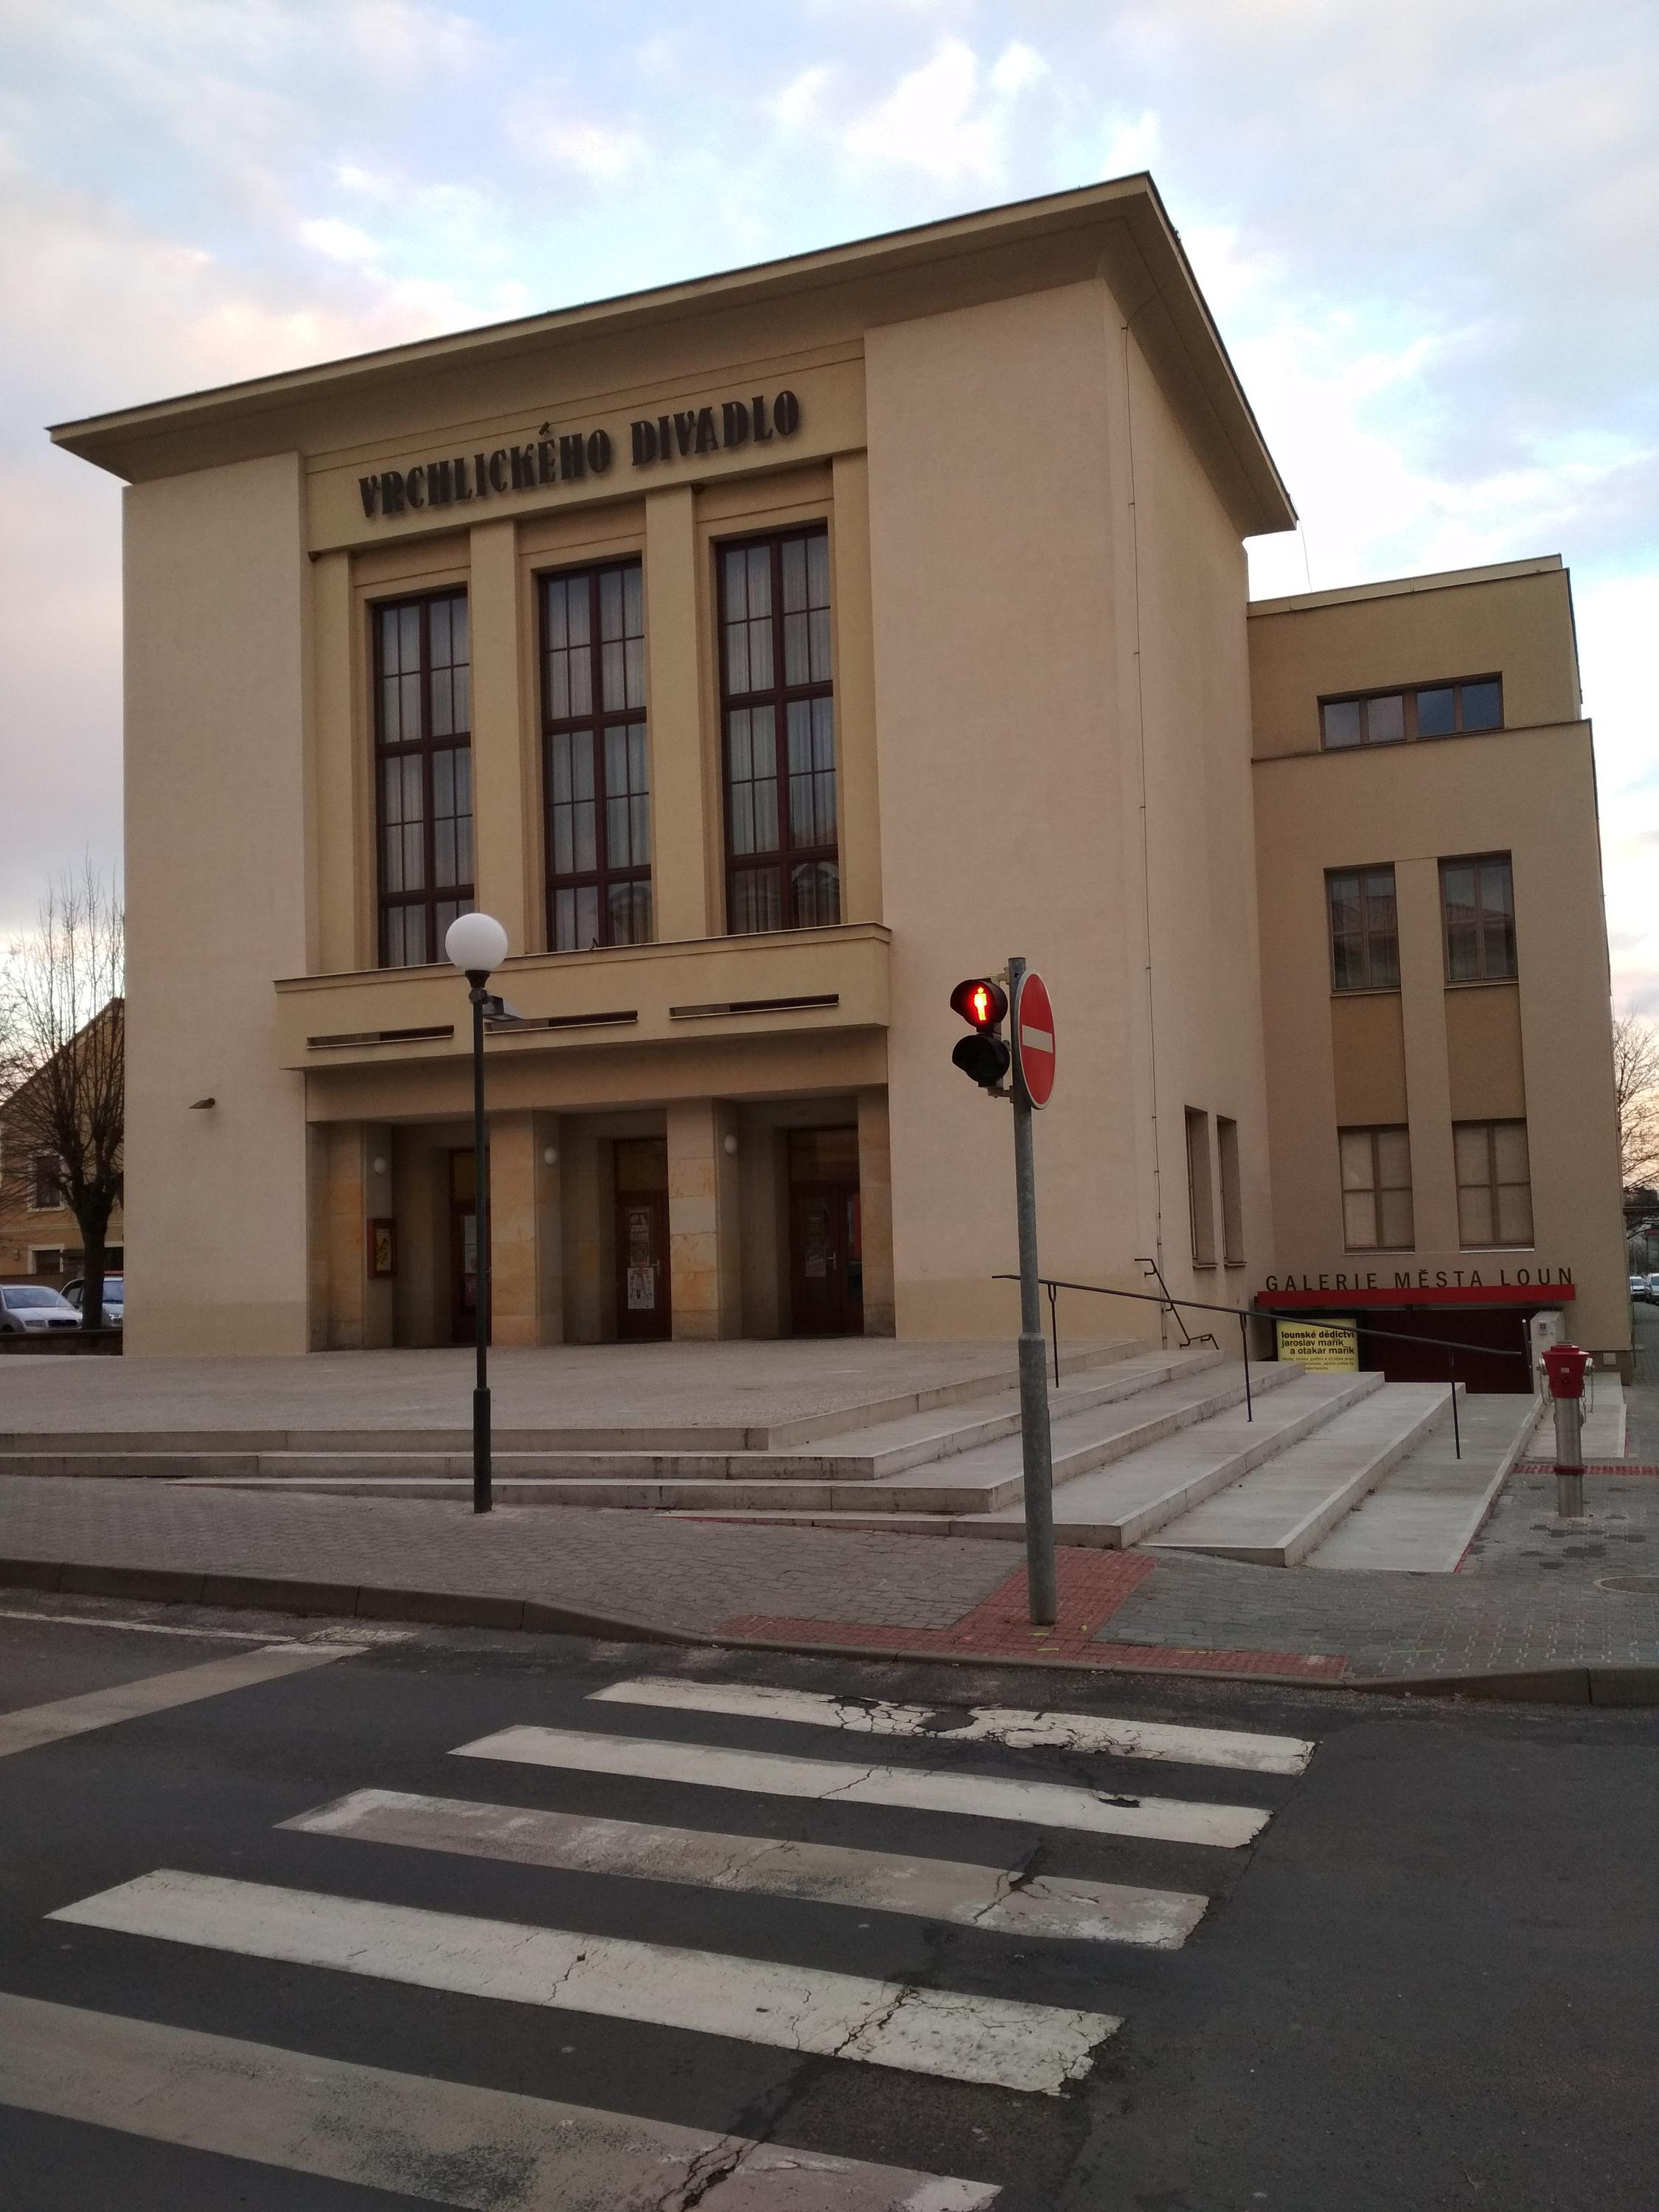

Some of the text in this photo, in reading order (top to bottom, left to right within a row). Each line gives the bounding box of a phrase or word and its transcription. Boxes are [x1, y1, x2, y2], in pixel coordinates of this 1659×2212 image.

[358, 389, 801, 518] VRCHLICKÉHO DIVADLO
[1265, 1267, 1572, 1291] GALERIE MĚSTA LOUN
[1281, 1330, 1316, 1338] lounské
[1281, 1339, 1315, 1348] jaroslav
[1298, 1346, 1326, 1354] otakar
